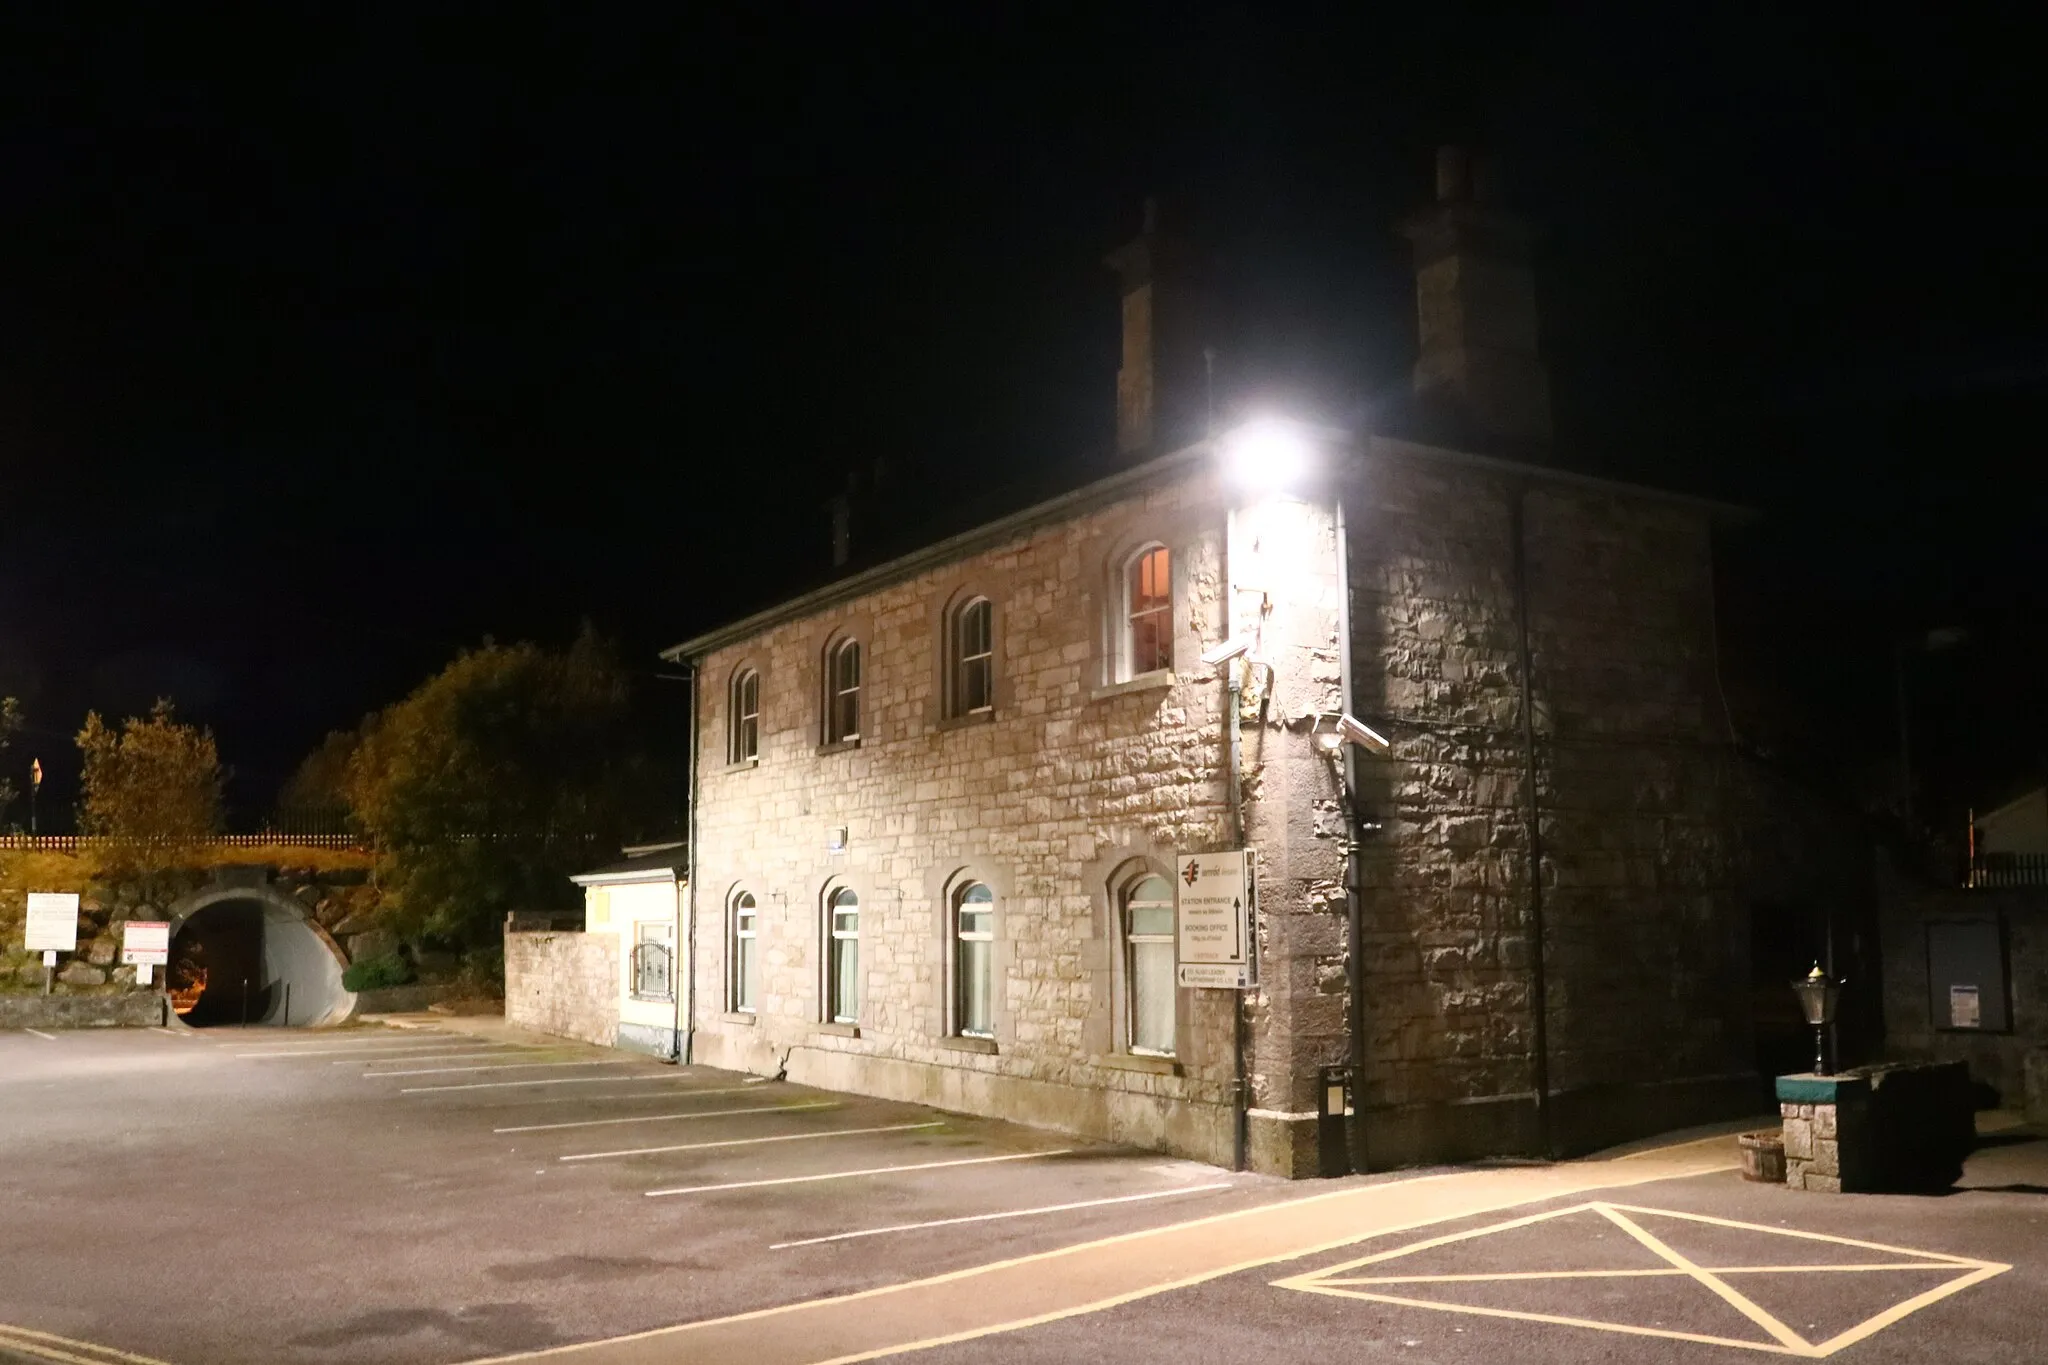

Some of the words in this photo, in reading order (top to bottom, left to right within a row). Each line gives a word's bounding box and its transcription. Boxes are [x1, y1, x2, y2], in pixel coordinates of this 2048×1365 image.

[1181, 897, 1202, 905] STATION
[1203, 896, 1231, 904] ENTRANCE
[1185, 924, 1208, 932] BOOKING
[1209, 923, 1228, 931] OFFICE
